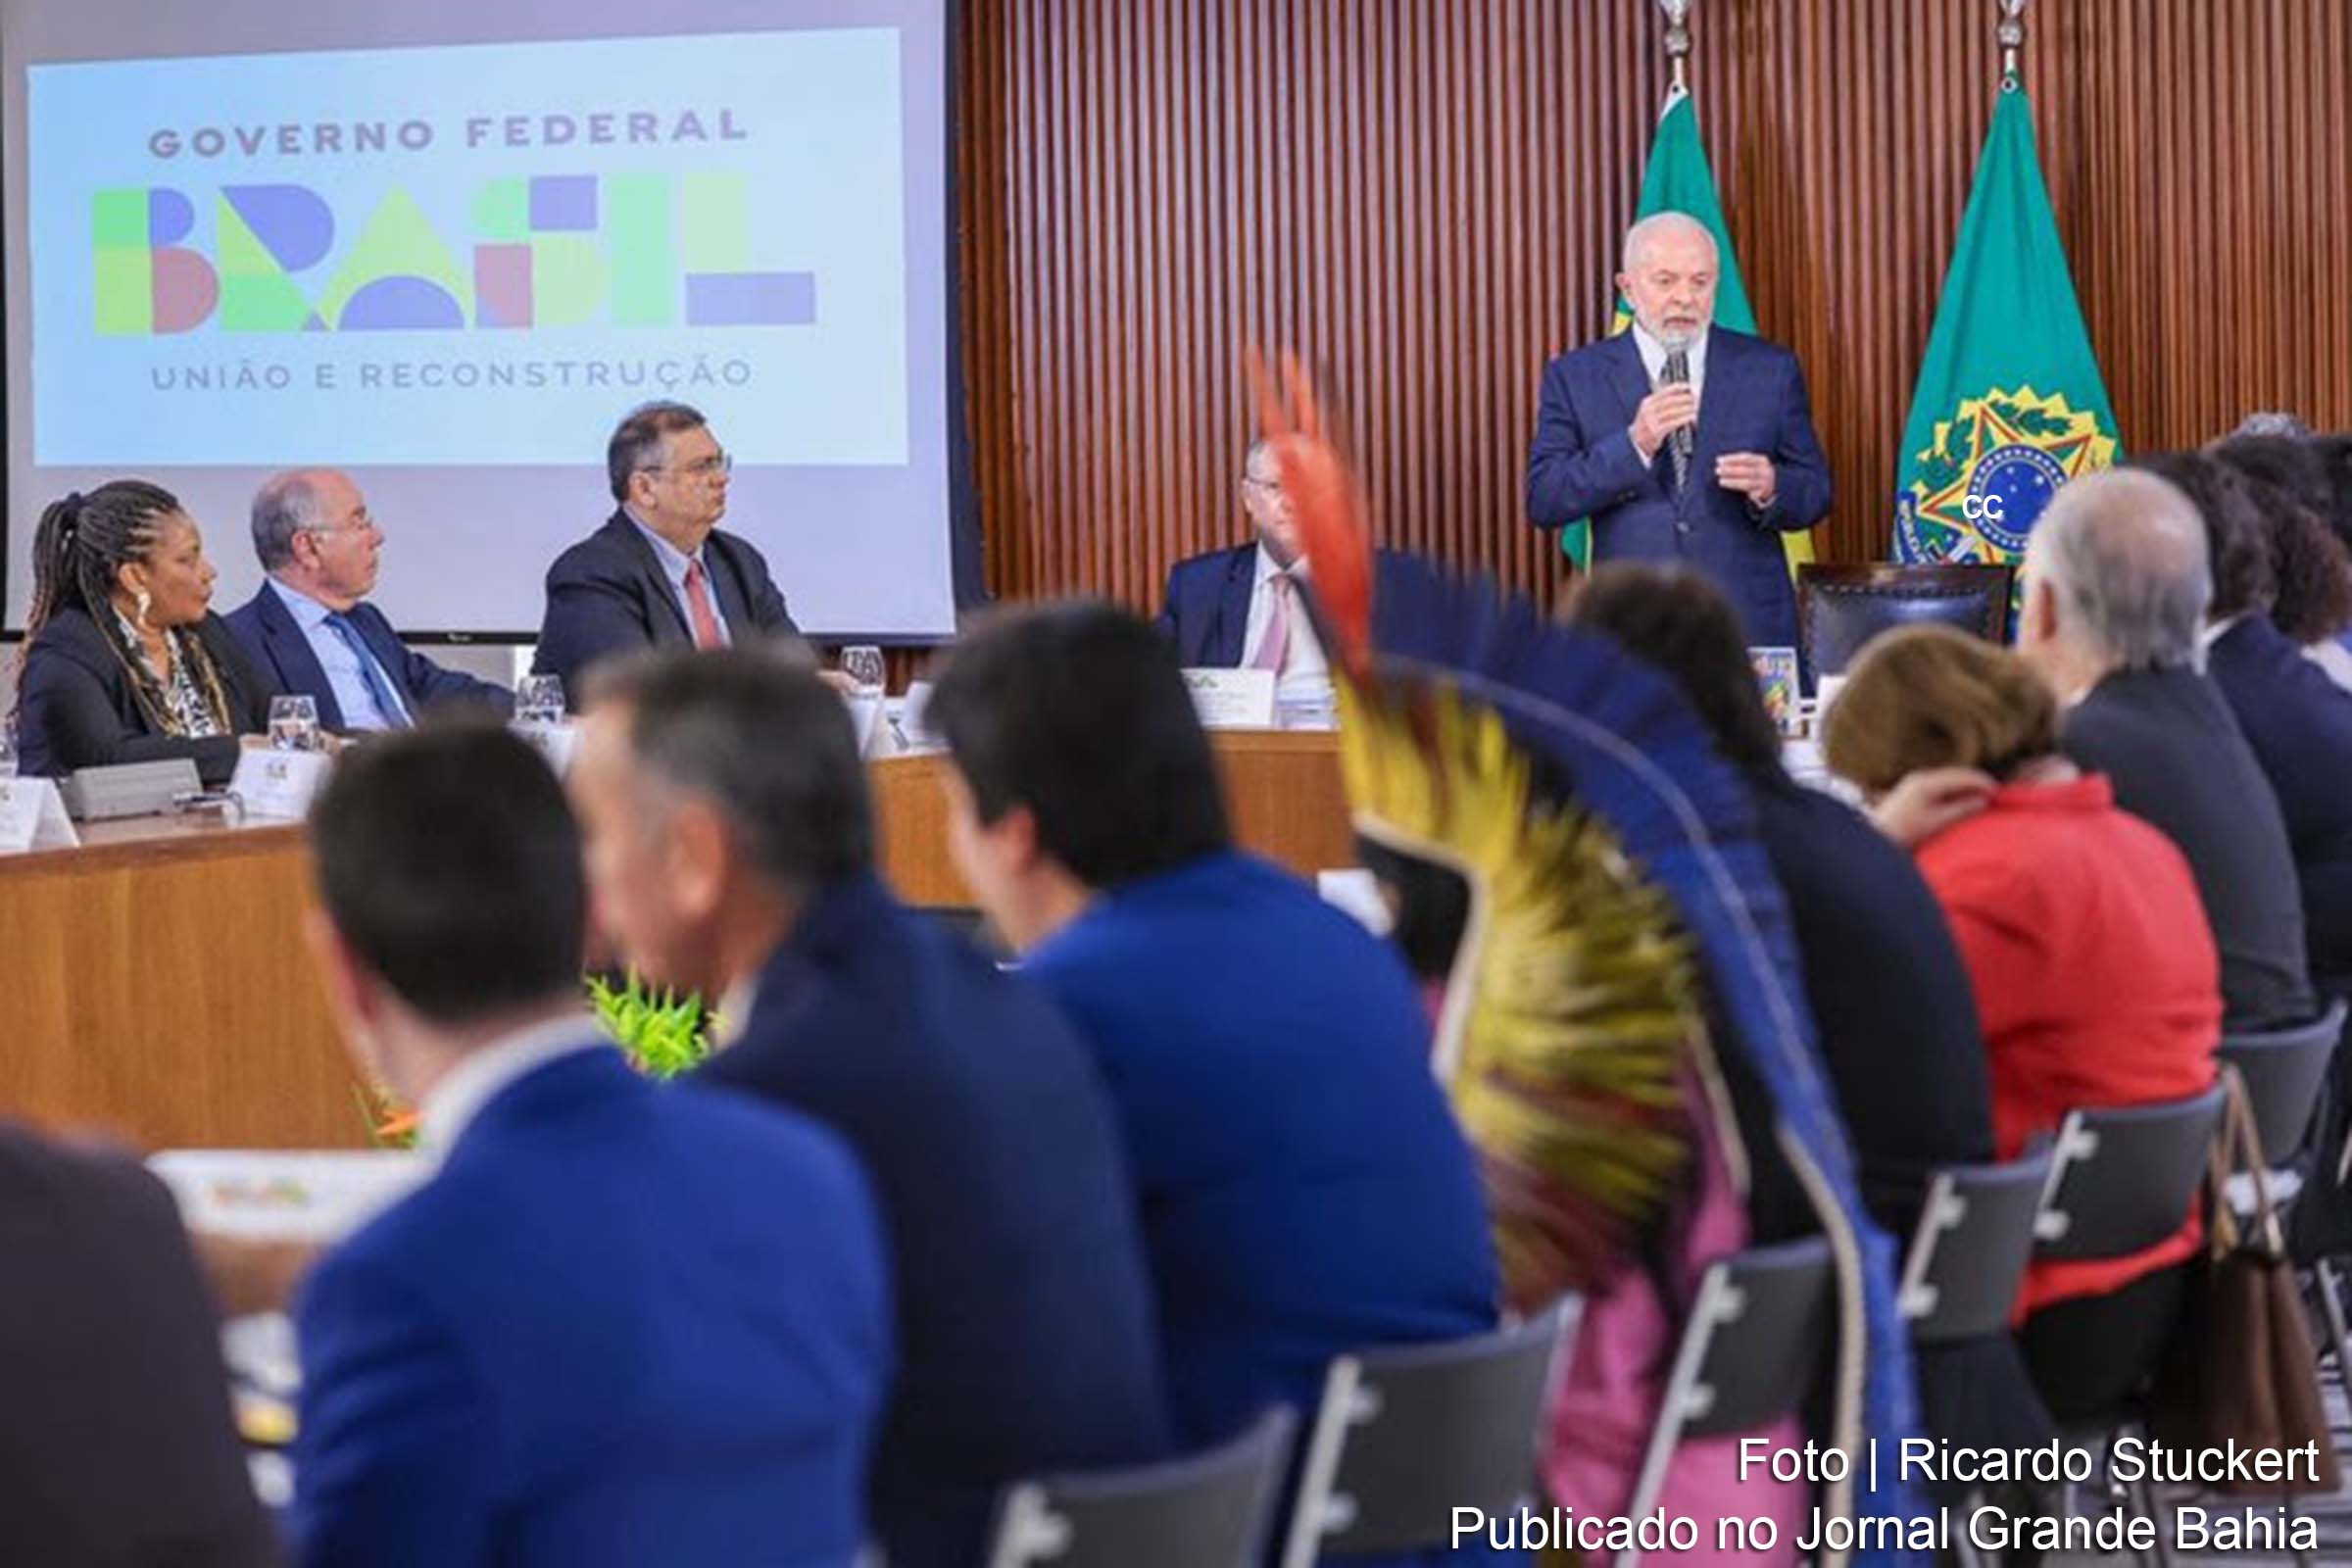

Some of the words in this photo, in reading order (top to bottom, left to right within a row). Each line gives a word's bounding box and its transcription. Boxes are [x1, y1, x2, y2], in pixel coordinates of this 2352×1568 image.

[147, 120, 434, 162] GOVERNO
[466, 109, 748, 149] FEDERAL
[92, 173, 816, 335] BRASIL
[150, 359, 293, 392] UNIÃO
[315, 364, 335, 389] E
[360, 354, 753, 403] RECONSTRUÇÃO
